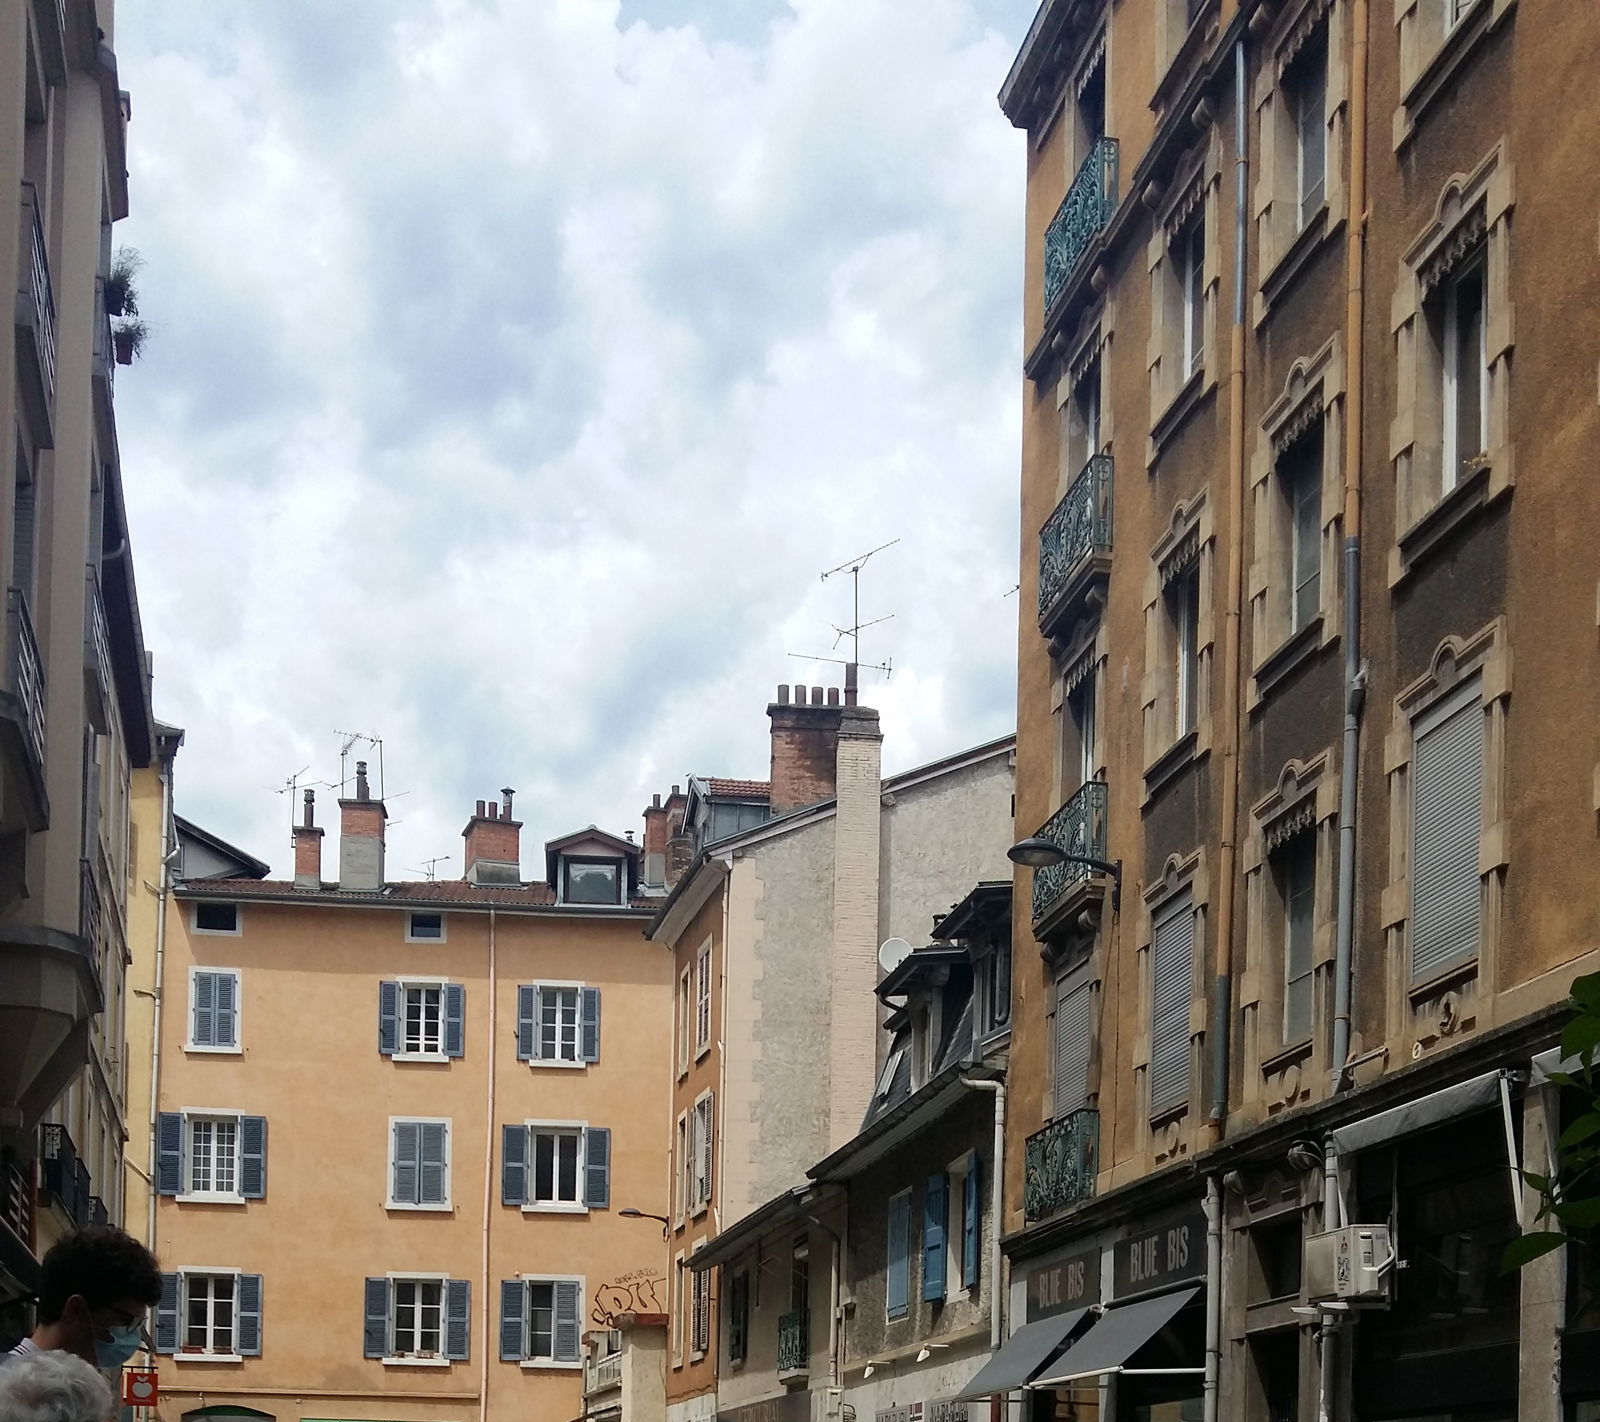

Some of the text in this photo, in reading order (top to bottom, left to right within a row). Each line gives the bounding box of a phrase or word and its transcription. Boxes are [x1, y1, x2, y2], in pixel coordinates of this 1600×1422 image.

[1129, 1225, 1189, 1283] BLUE BIS
[1039, 1260, 1085, 1309] BLUE BIS
